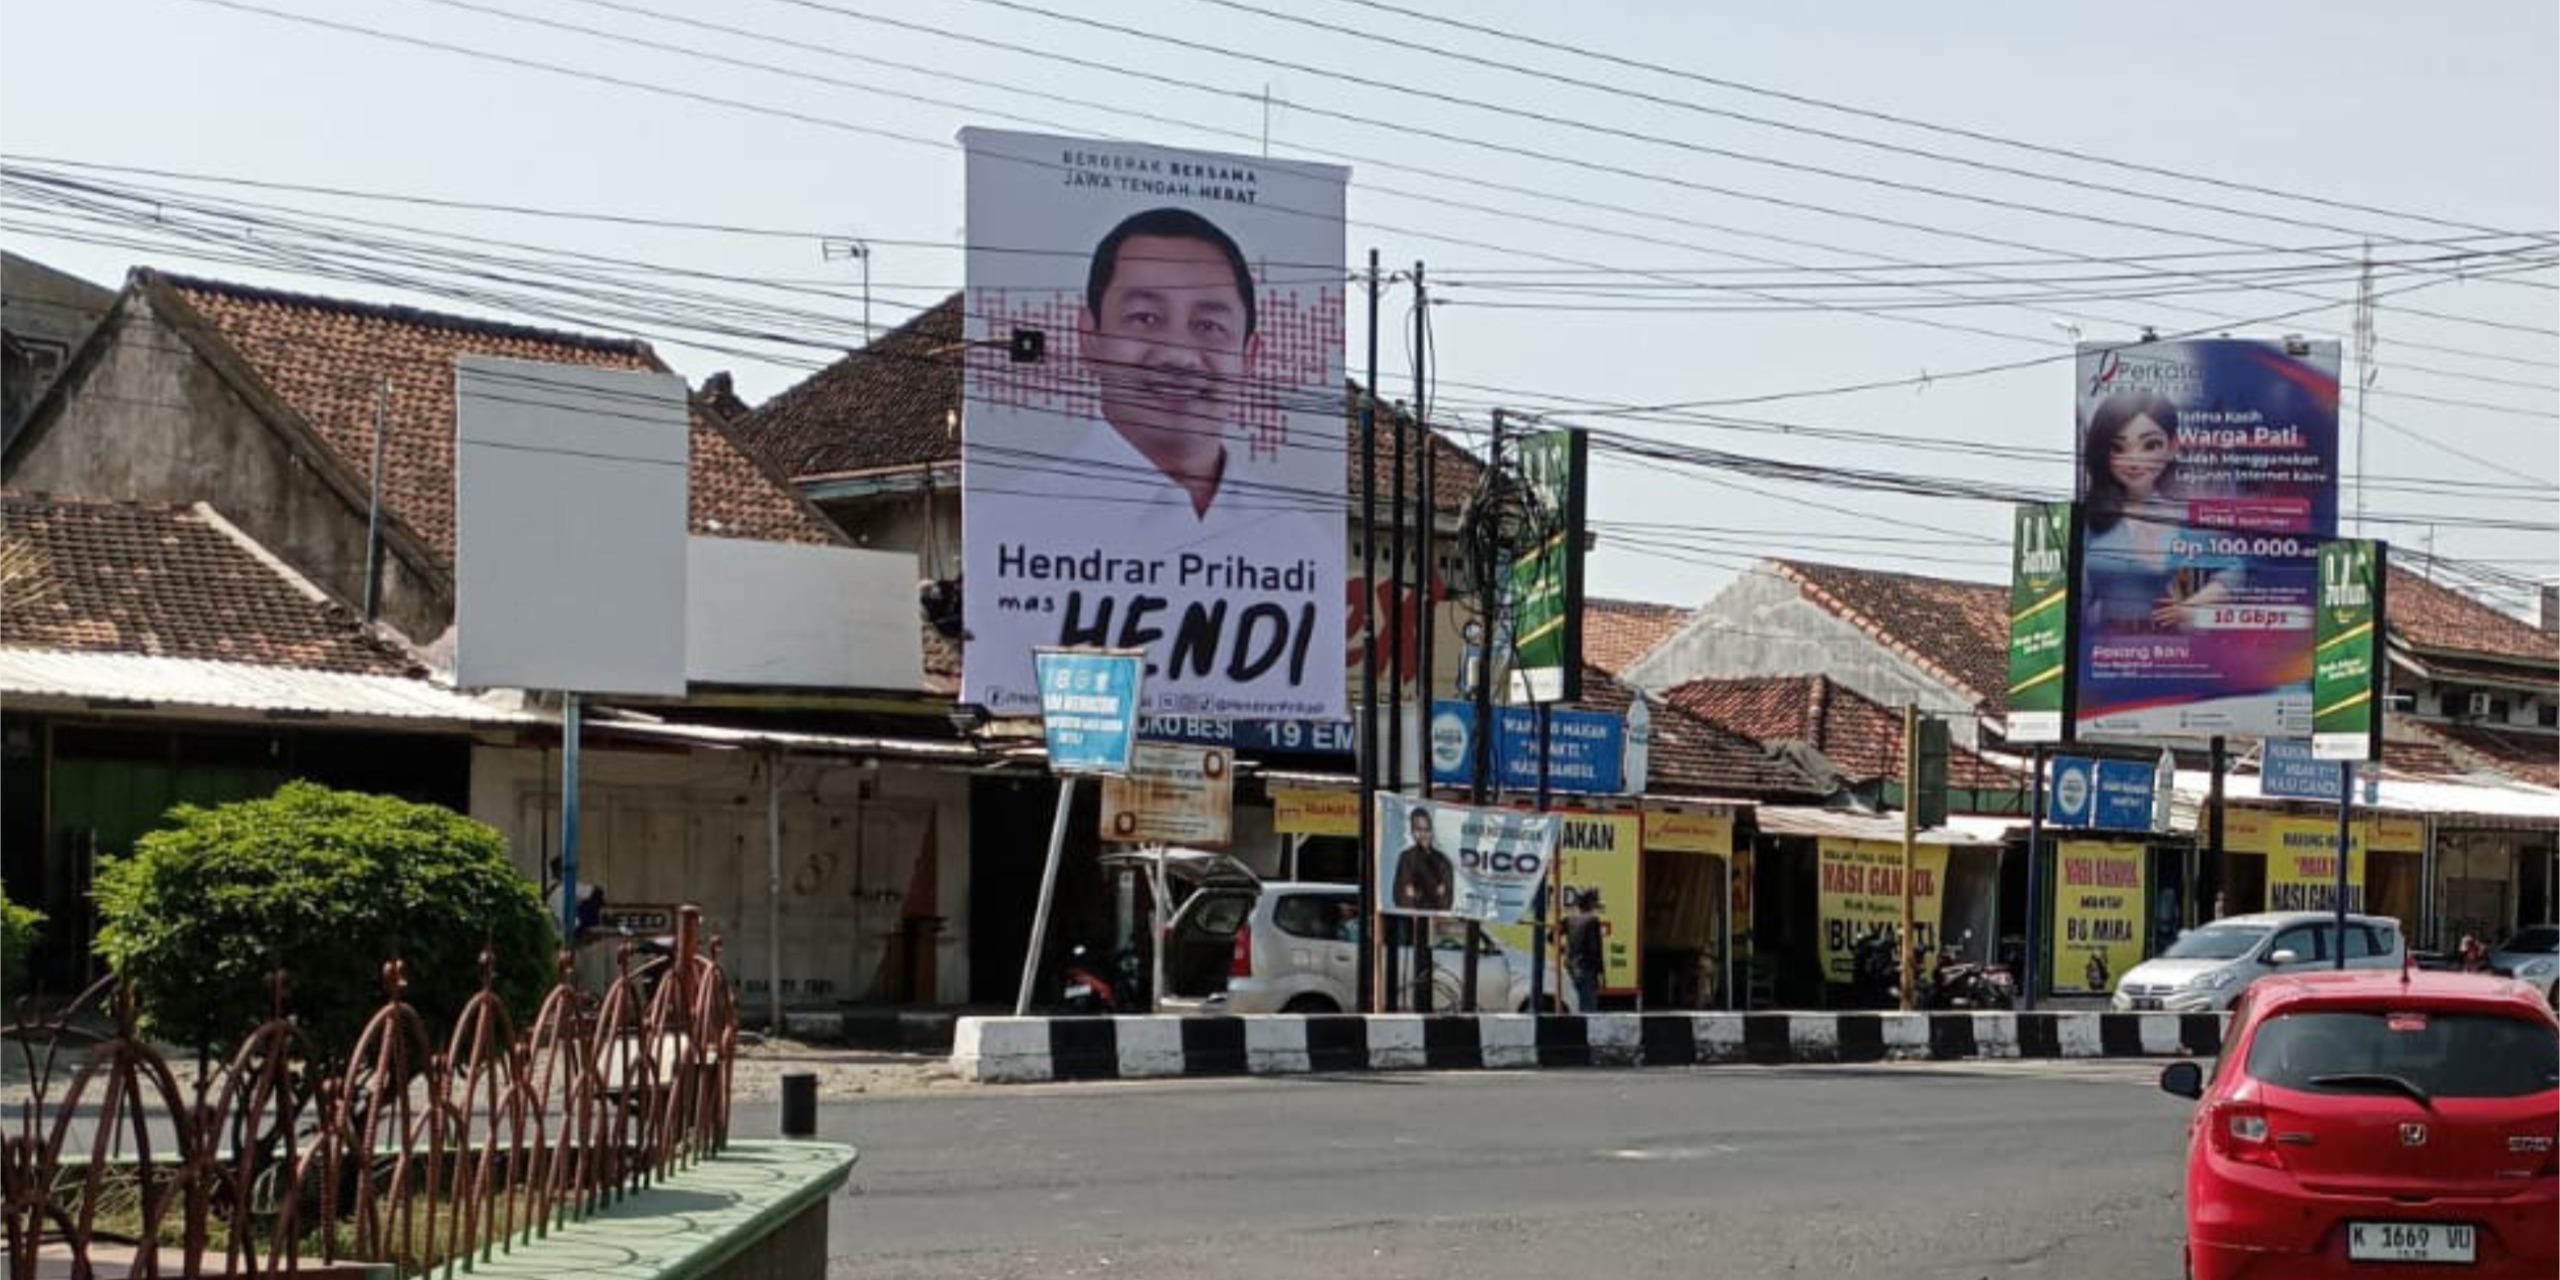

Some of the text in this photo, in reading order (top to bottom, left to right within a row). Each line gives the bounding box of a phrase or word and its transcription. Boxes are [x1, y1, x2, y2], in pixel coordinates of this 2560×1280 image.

[1170, 163, 1257, 184] BERSAMA
[1064, 172, 1112, 189] JAWA
[1200, 185, 1258, 204] HEBAT
[2176, 425, 2299, 448] Warga Pati
[2171, 539, 2203, 559] Rp
[998, 544, 1316, 592] Hendrar Prihadi
[999, 594, 1055, 613] mas
[1060, 590, 1316, 687] HENDI
[1187, 717, 1234, 740] BESI
[1266, 721, 1302, 748] 19
[1563, 821, 1615, 851] AKAN
[1460, 849, 1541, 874] DICO
[1868, 867, 1935, 897] GANUL
[2353, 1226, 2365, 1247] K
[2383, 1225, 2429, 1248] 1669
